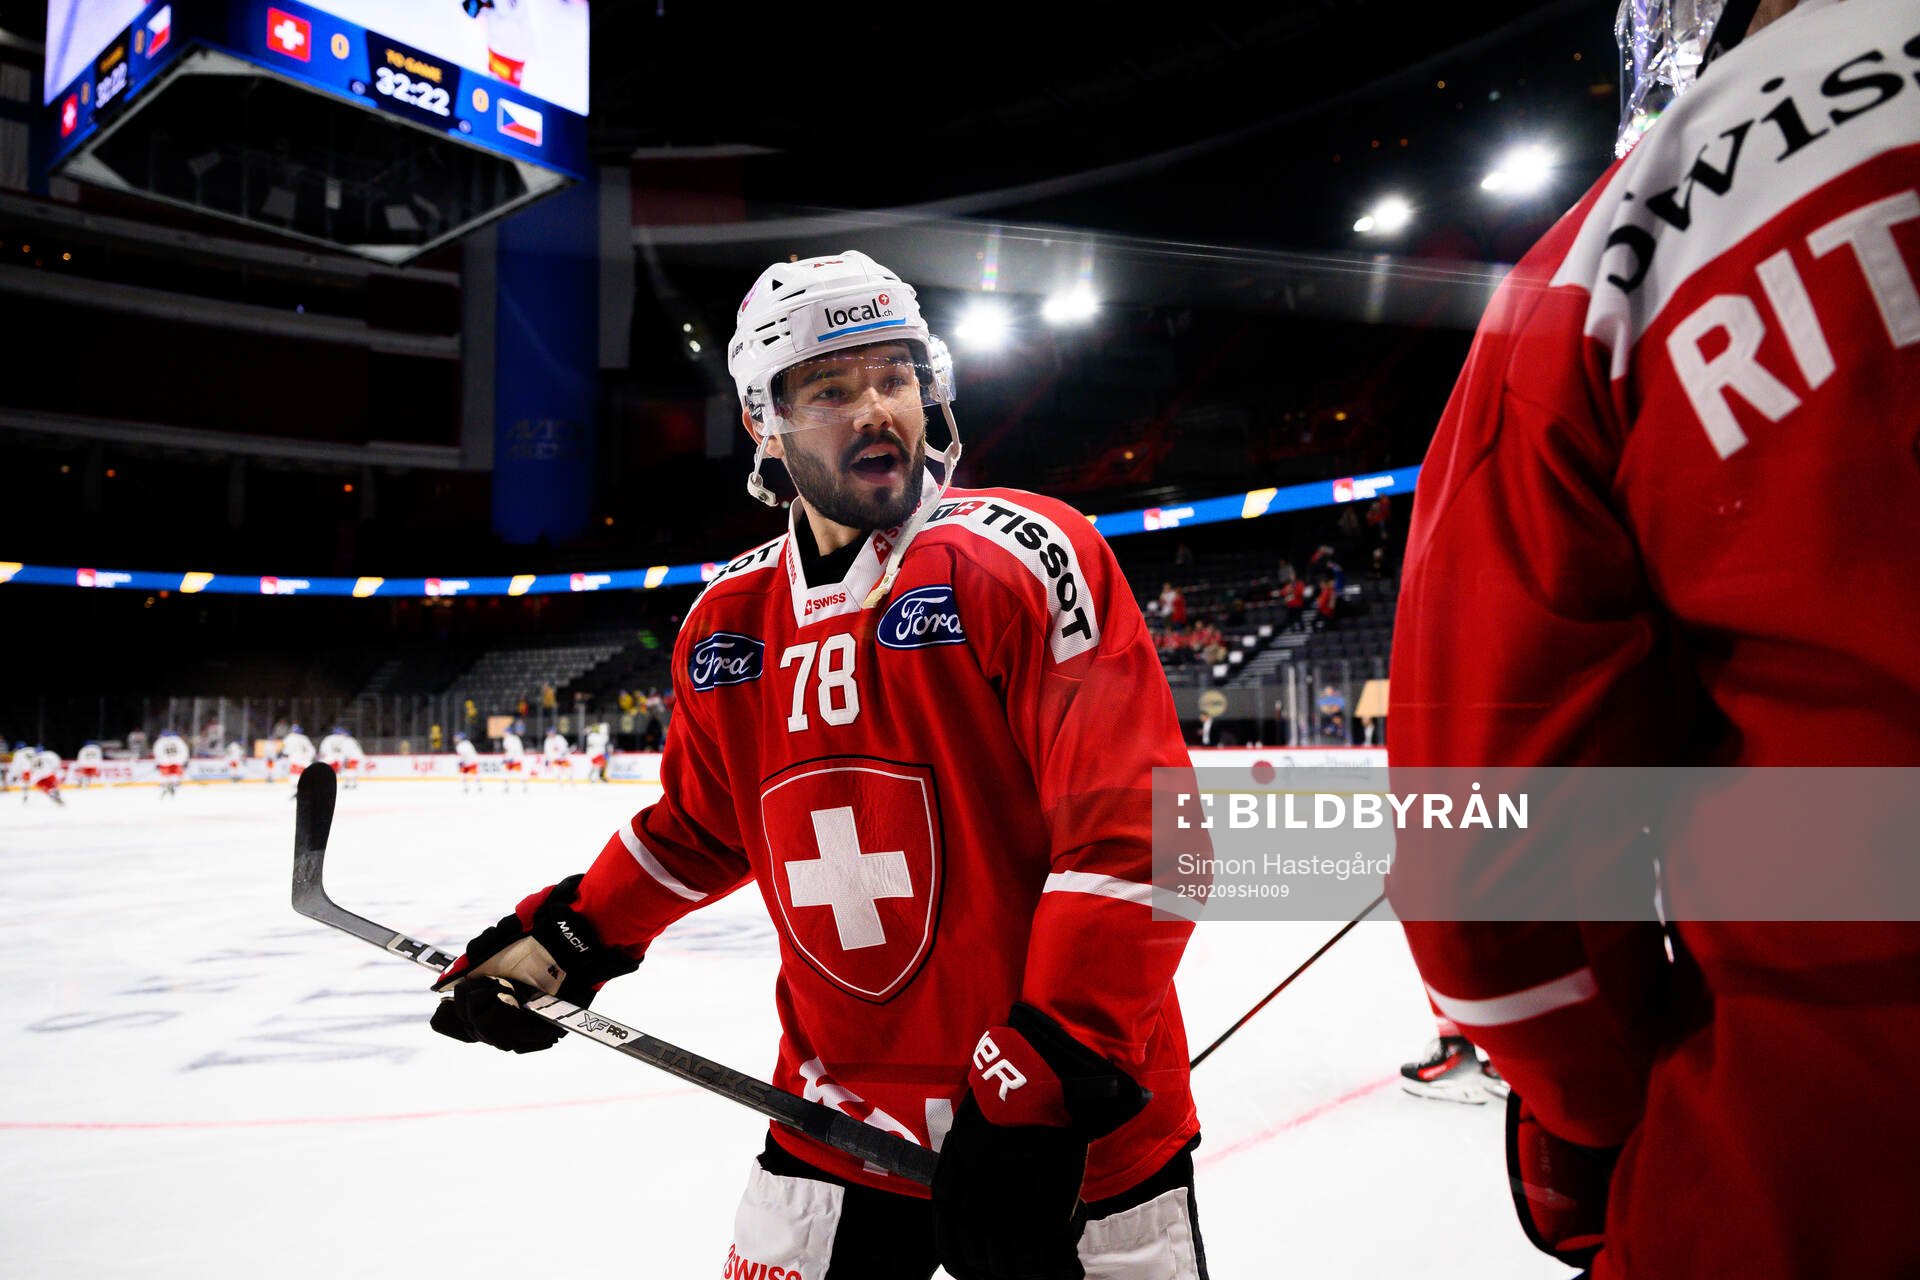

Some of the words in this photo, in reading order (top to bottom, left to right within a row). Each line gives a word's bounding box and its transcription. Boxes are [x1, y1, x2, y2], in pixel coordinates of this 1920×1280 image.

[331, 33, 350, 60] 0
[376, 66, 451, 117] 32:22
[472, 88, 490, 113] 0
[1604, 33, 1920, 293] wis
[982, 504, 1092, 641] TISSOT
[813, 592, 847, 610] SWISS
[694, 642, 753, 685] Frd
[779, 632, 861, 733] 78
[557, 920, 589, 953] MACH
[607, 1024, 629, 1040] PRO
[653, 1041, 771, 1106] TACKS
